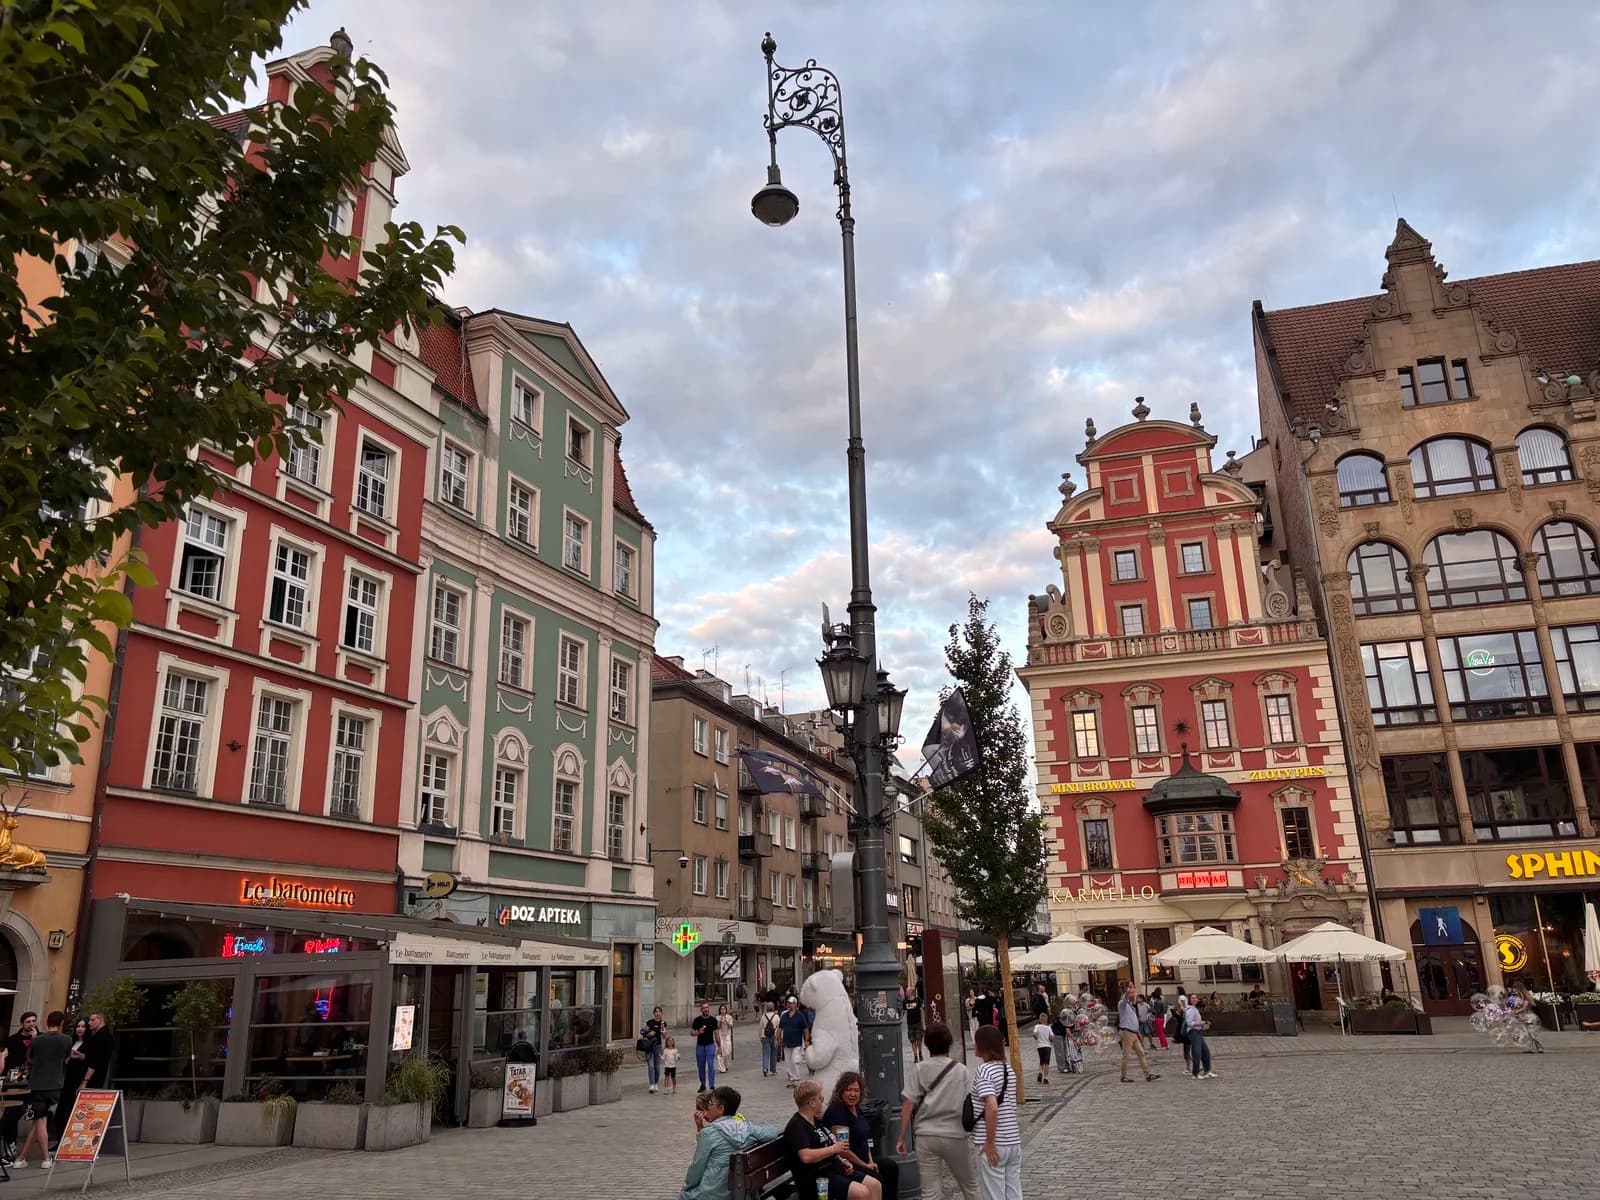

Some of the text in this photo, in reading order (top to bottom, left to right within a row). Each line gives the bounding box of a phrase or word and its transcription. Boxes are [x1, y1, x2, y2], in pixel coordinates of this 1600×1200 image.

[1295, 766, 1326, 777] PIES
[1051, 779, 1136, 793] MINI BROWAR
[242, 877, 356, 906] Le barometre
[1052, 885, 1154, 904] KARMELLO
[511, 905, 581, 925] DOZ APTEKA
